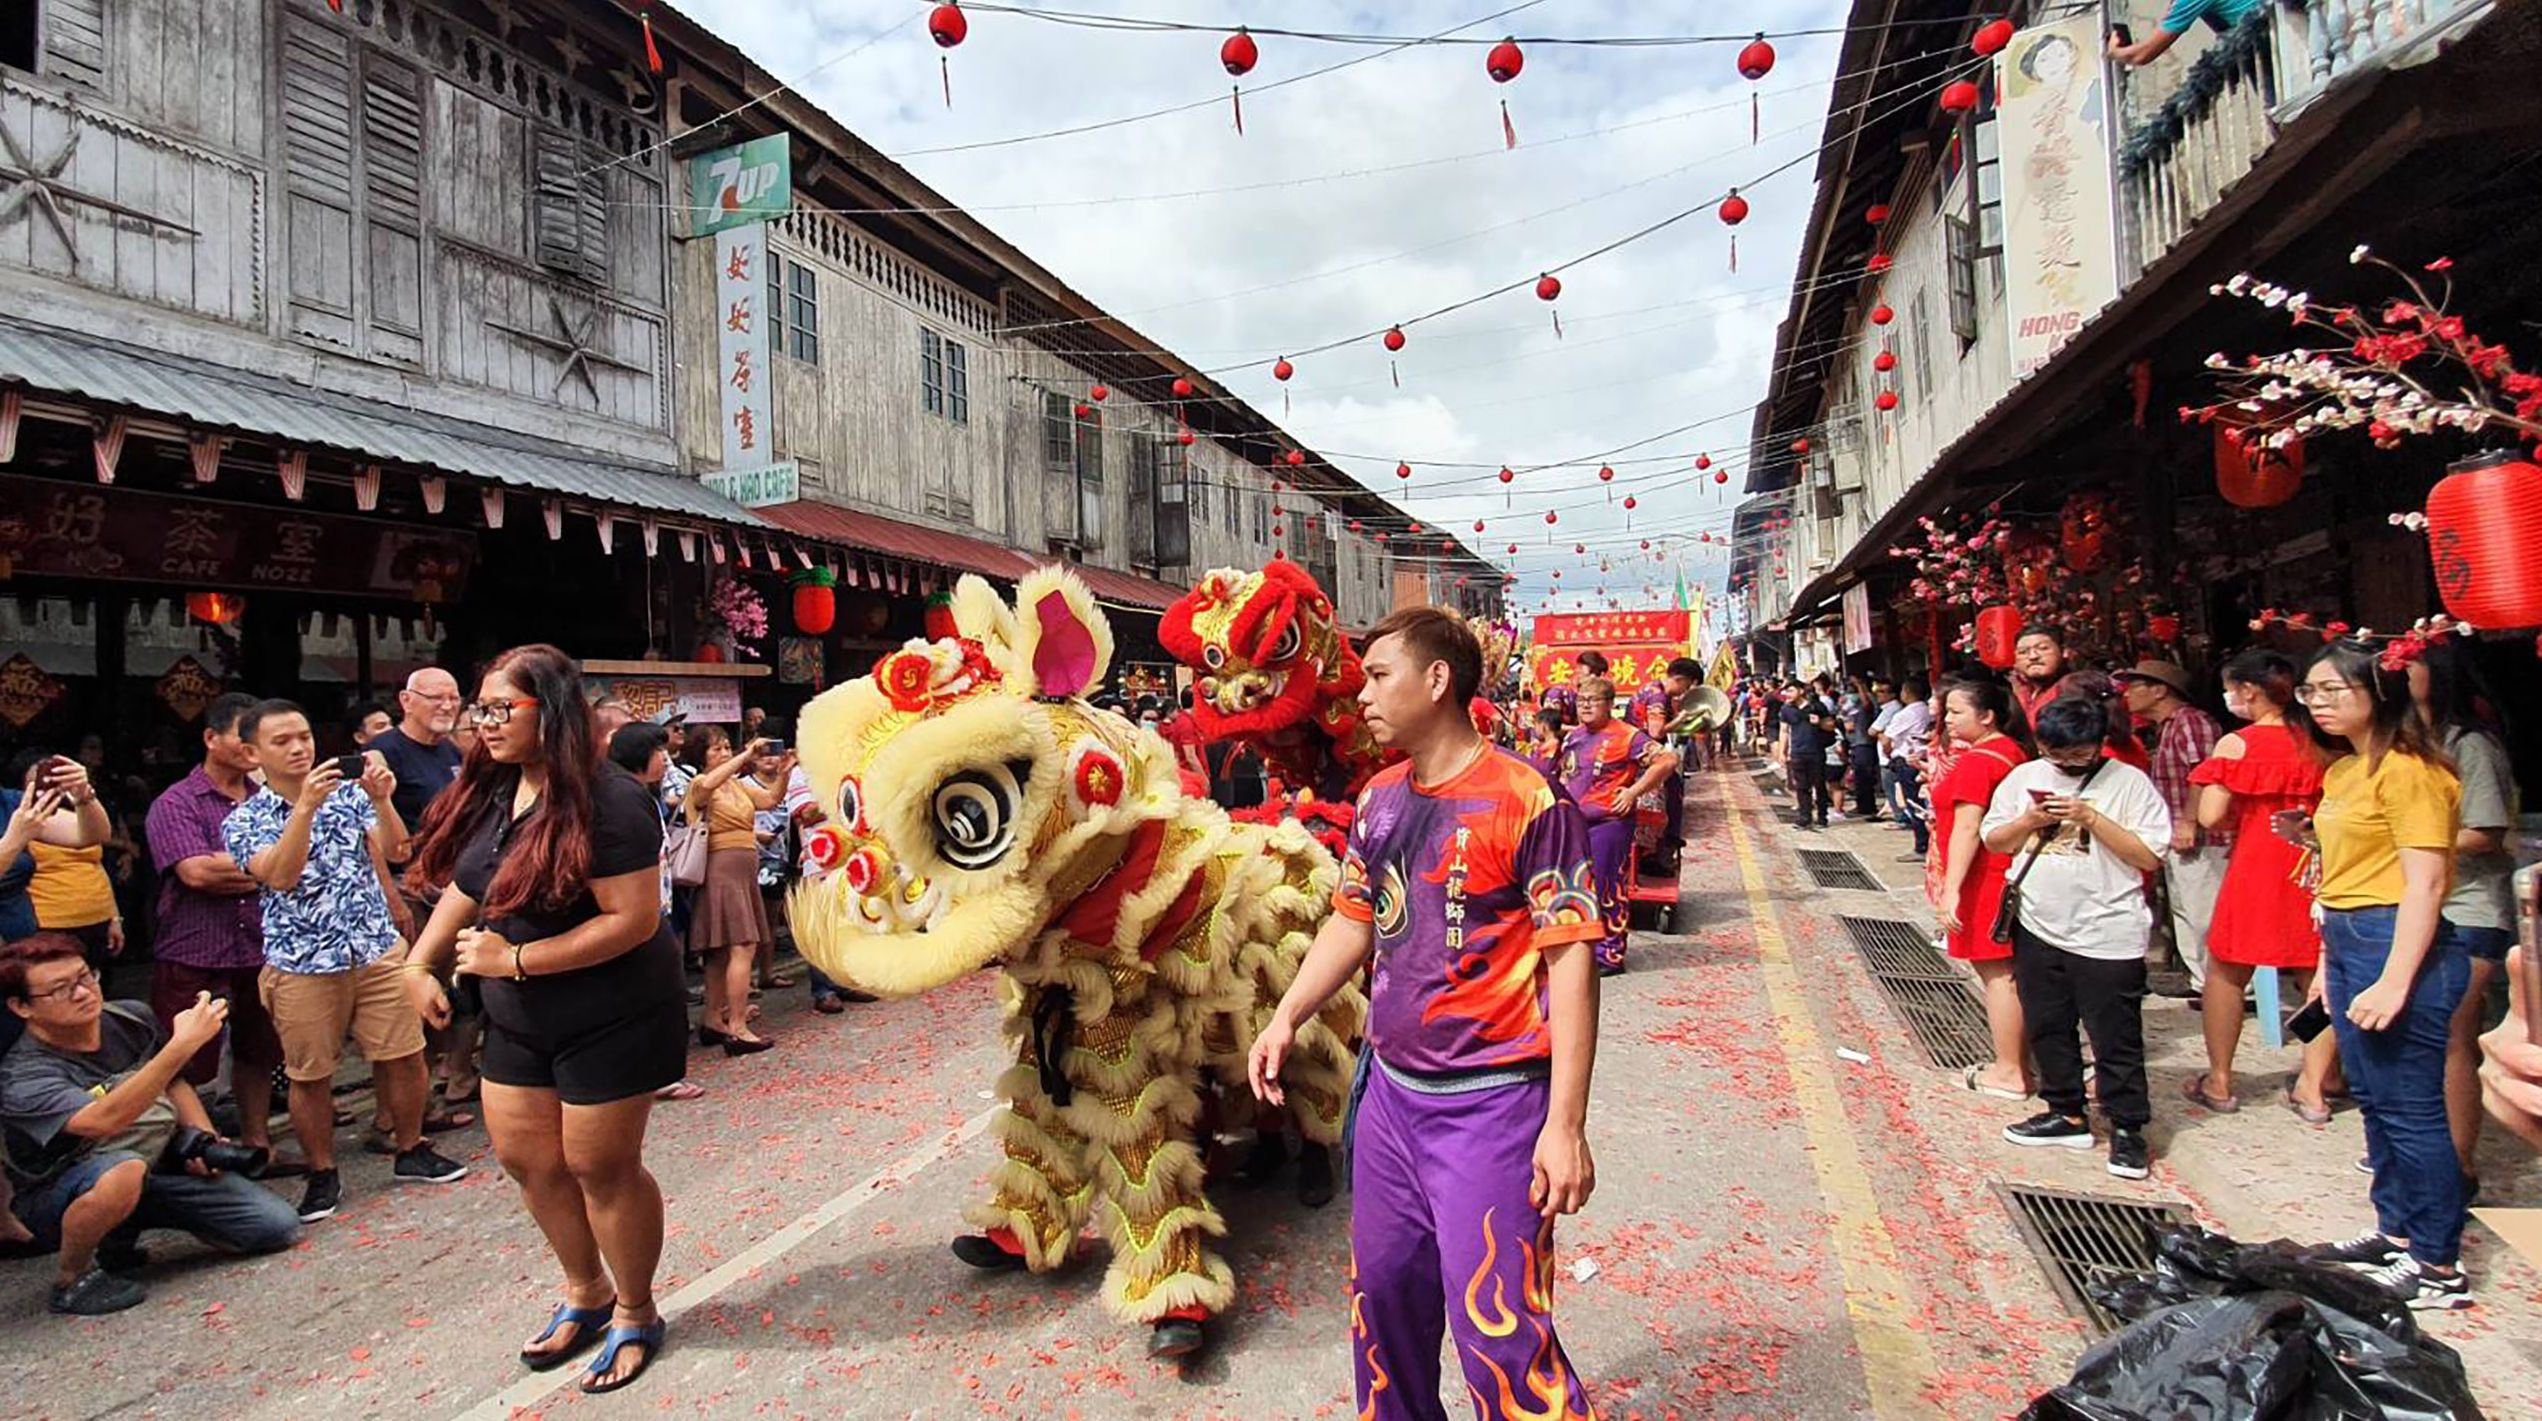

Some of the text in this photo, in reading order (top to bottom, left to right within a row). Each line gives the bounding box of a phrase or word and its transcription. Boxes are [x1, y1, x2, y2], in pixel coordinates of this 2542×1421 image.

[707, 157, 779, 224] 7UP
[2018, 311, 2081, 339] HONG
[765, 467, 793, 498] CAFE
[161, 557, 222, 576] CAFE
